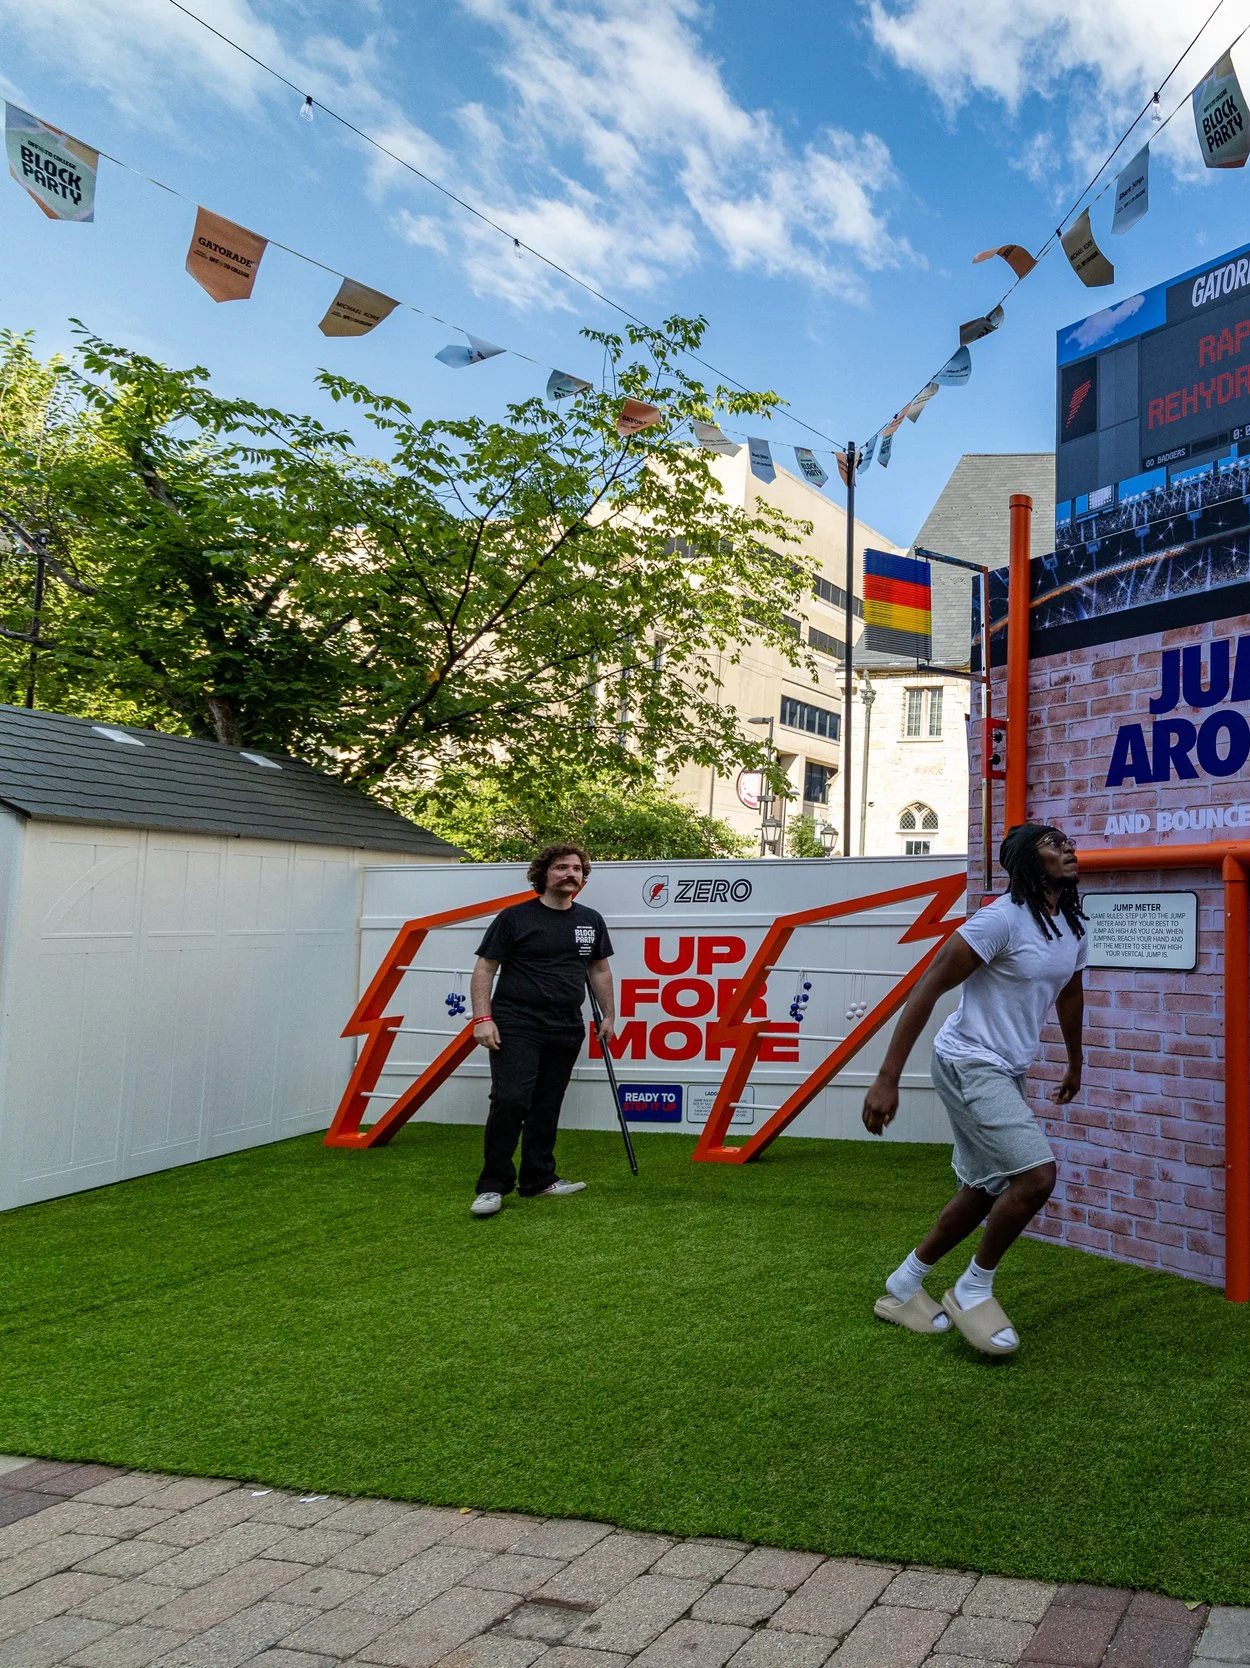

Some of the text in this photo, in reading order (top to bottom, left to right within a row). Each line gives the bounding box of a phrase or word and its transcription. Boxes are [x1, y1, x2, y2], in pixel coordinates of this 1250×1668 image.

[1202, 94, 1239, 137] BLOCK
[1206, 112, 1244, 153] PARTY
[20, 144, 82, 191] BLOCK
[21, 160, 82, 206] PARTY
[198, 236, 252, 268] GATORADE
[1145, 459, 1155, 468] GO
[1157, 447, 1186, 465] BADGERS
[1104, 814, 1151, 836] AND
[1156, 805, 1250, 833] BOUNCE
[674, 878, 753, 903] ZERO
[574, 929, 596, 937] BLOCK
[575, 936, 595, 944] PARTY
[643, 935, 747, 976] UP
[623, 1102, 677, 1112] STEP IT UP
[625, 1092, 676, 1102] READY TO
